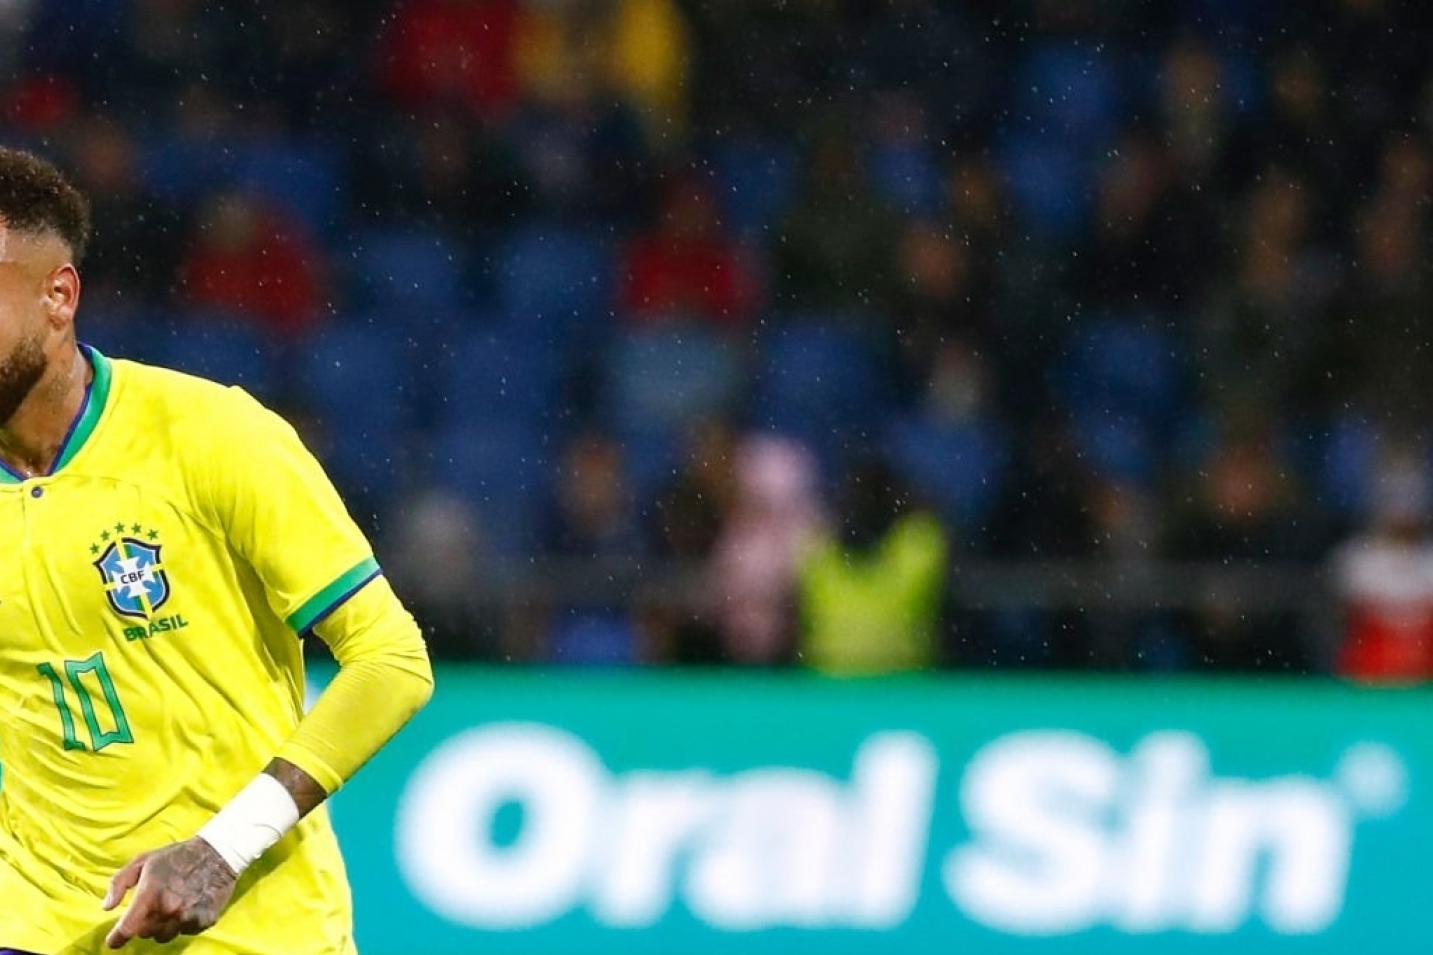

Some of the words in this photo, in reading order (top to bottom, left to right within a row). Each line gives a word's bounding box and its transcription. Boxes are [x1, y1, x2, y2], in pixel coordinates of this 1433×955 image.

[120, 571, 146, 585] CBF
[123, 614, 189, 642] BRASIL
[35, 650, 135, 752] 10
[395, 722, 936, 930] Oral
[942, 730, 1352, 934] Sin
